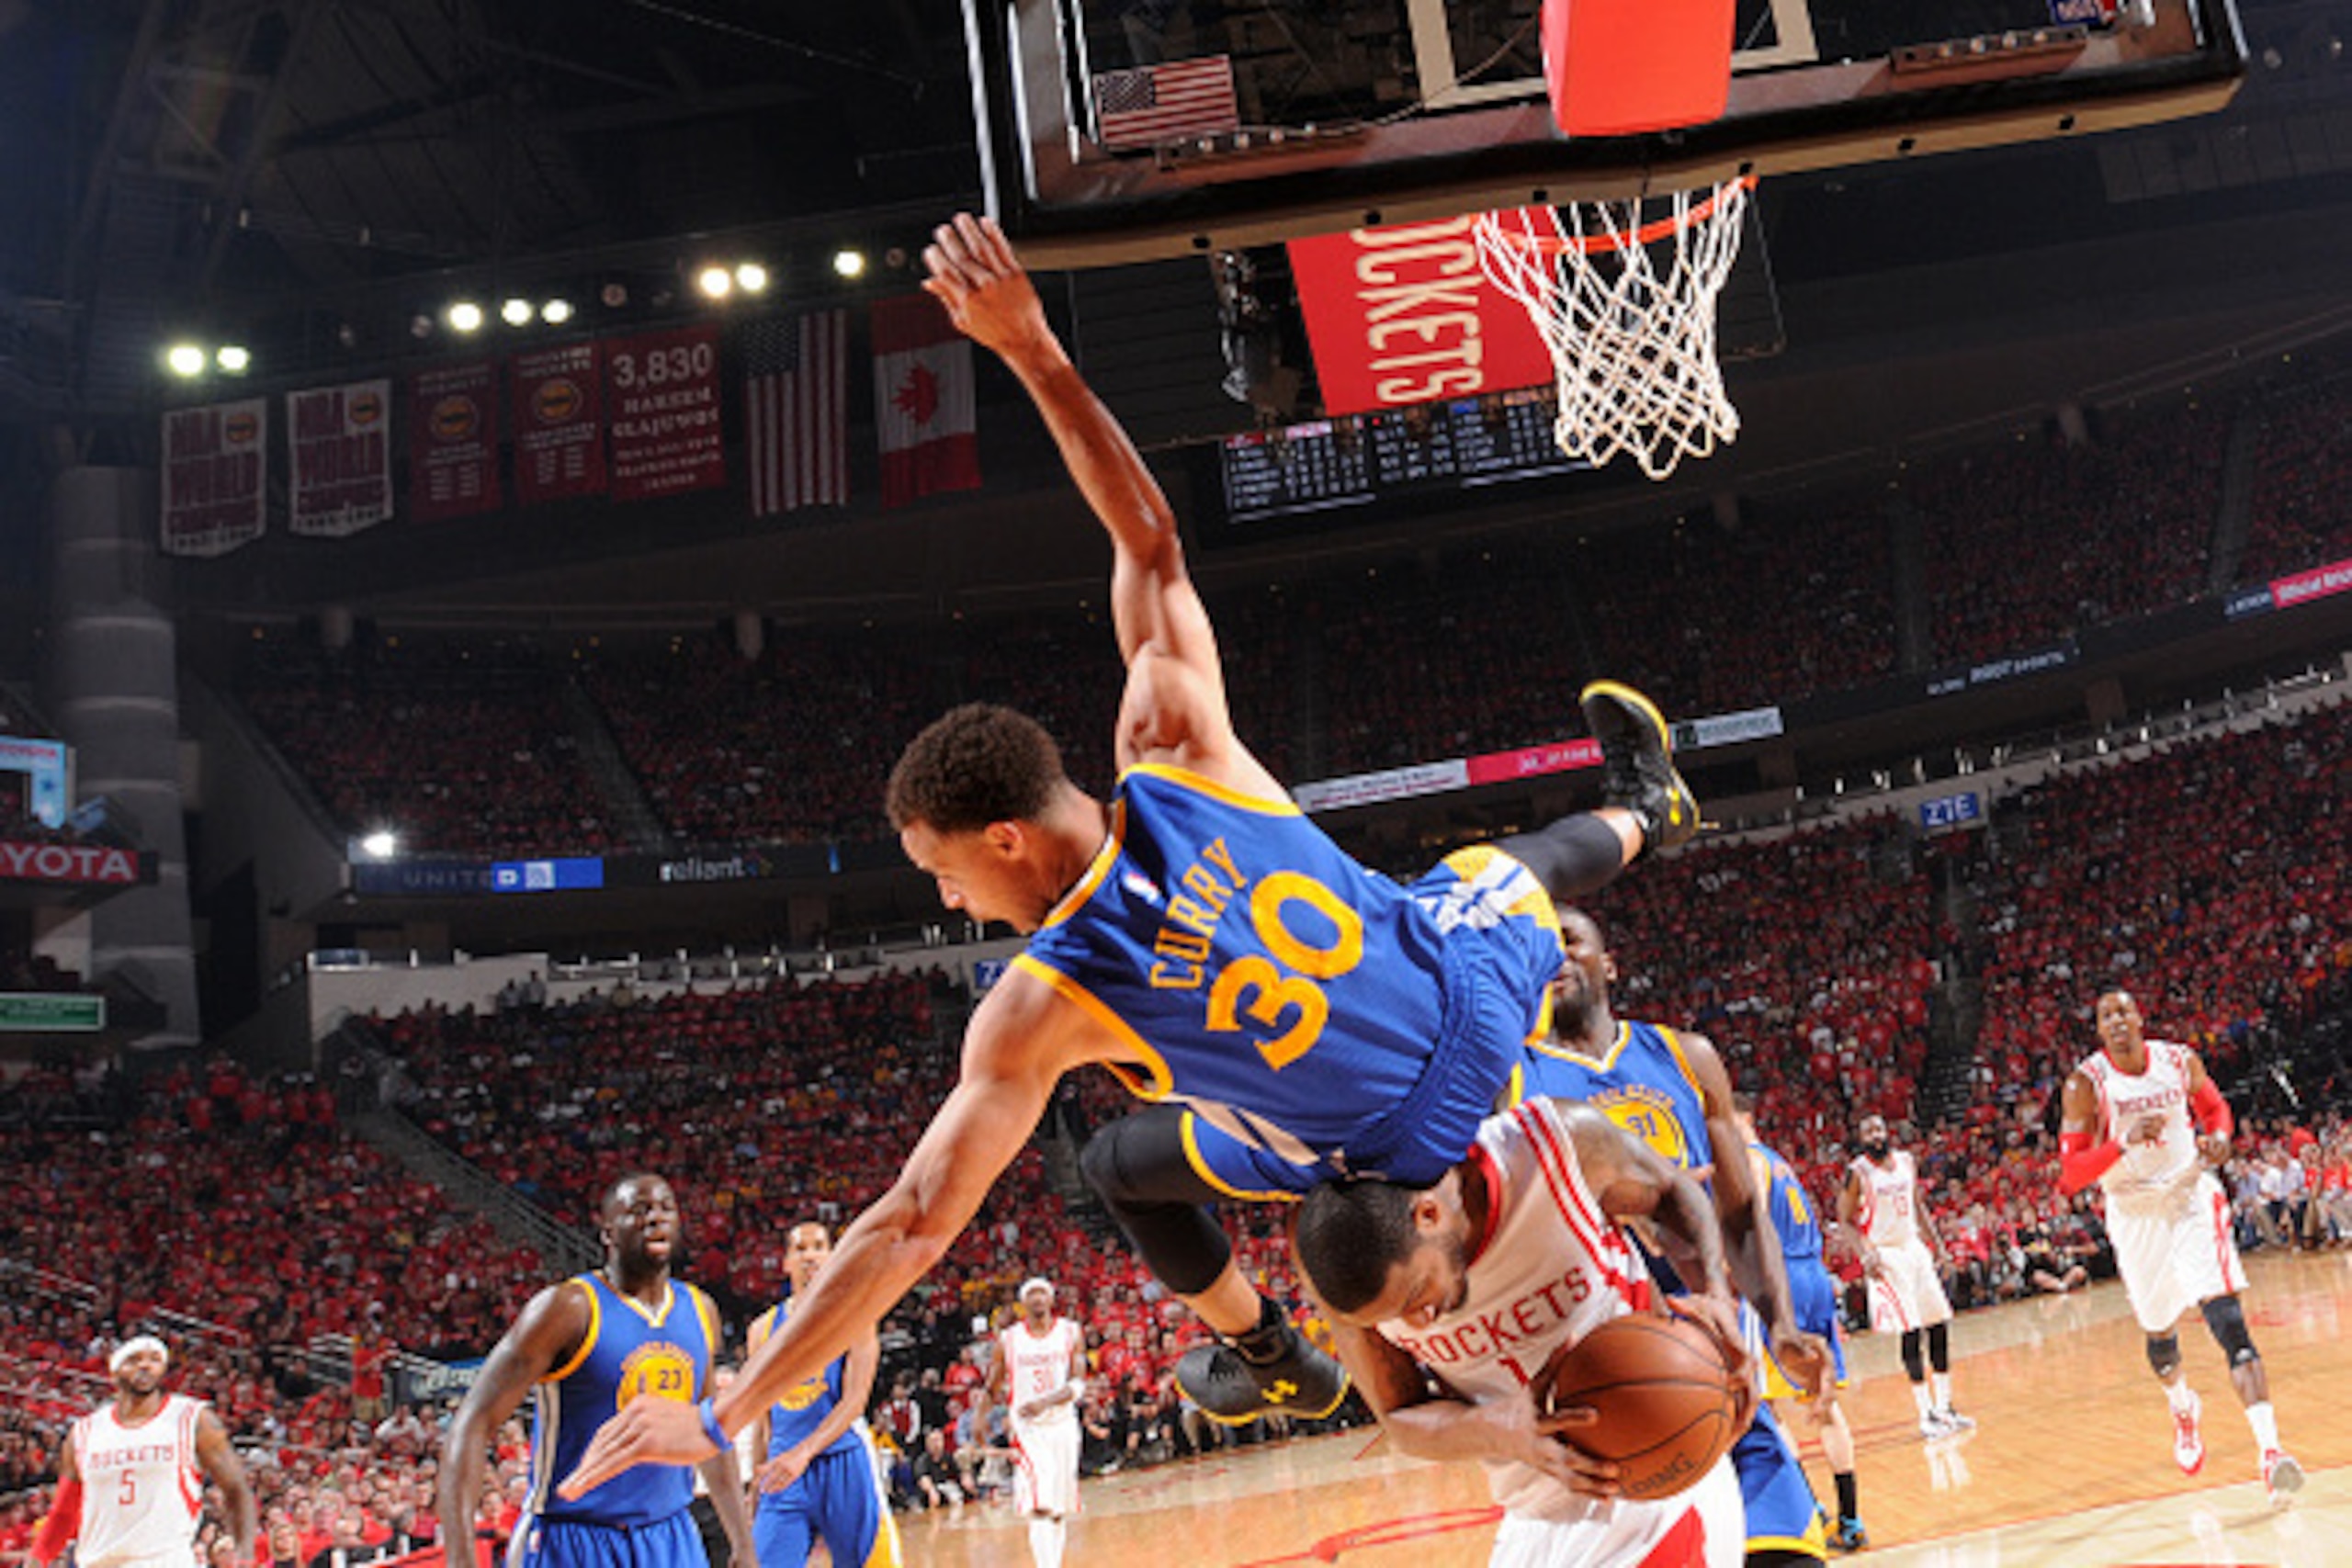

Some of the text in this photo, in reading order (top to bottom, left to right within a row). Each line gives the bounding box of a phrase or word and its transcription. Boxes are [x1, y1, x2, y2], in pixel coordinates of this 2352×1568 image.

[613, 343, 713, 392] 3,830
[1924, 795, 1974, 825] ZTE
[0, 845, 134, 877] YOTA
[660, 857, 743, 882] reliant
[1150, 837, 1247, 988] CURRY
[1205, 870, 1363, 1072] 30
[1397, 1266, 1591, 1364] ROCKETS
[658, 1369, 682, 1391] 23
[88, 1443, 175, 1469] ROCKETS
[119, 1468, 136, 1506] 5
